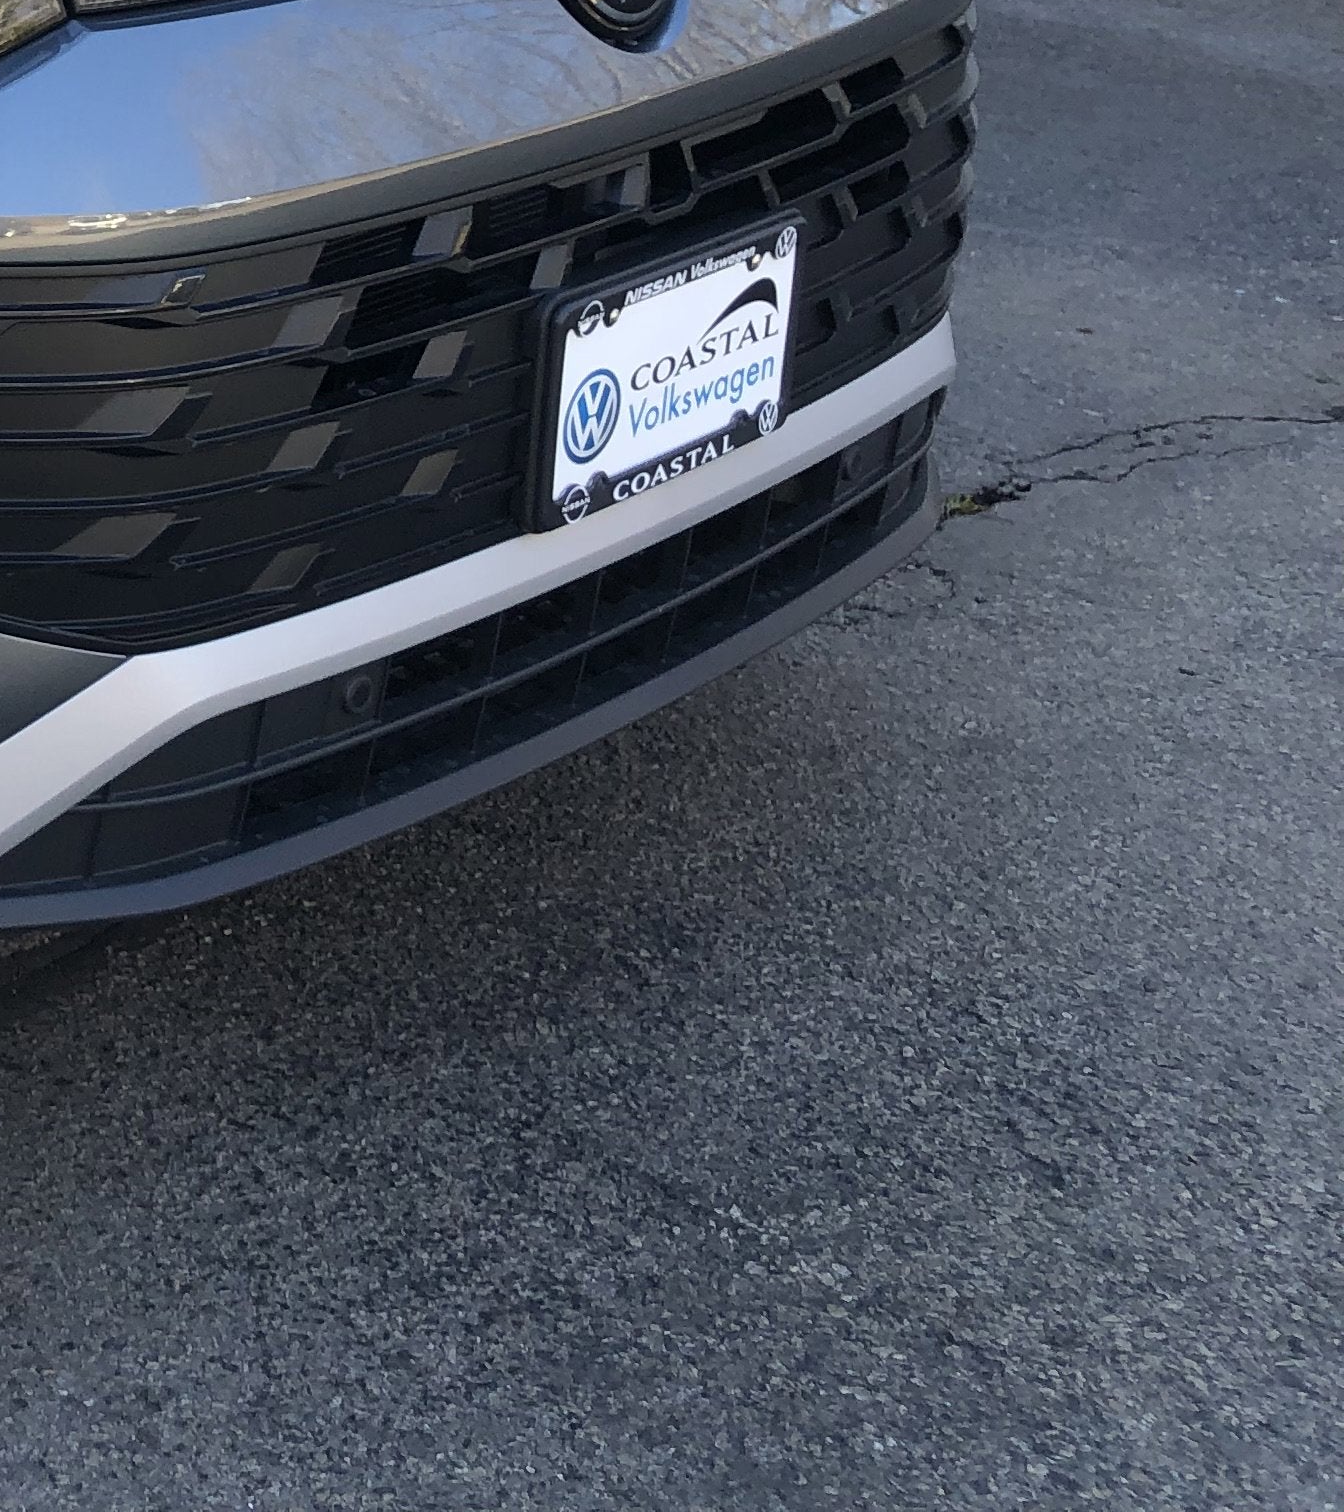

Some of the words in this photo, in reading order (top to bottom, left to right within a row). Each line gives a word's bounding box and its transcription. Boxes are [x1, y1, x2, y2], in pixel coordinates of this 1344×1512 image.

[624, 269, 688, 306] NISSAN
[630, 312, 779, 391] COASTAL
[628, 355, 775, 438] Volkswagen
[612, 434, 735, 501] COASTAL
